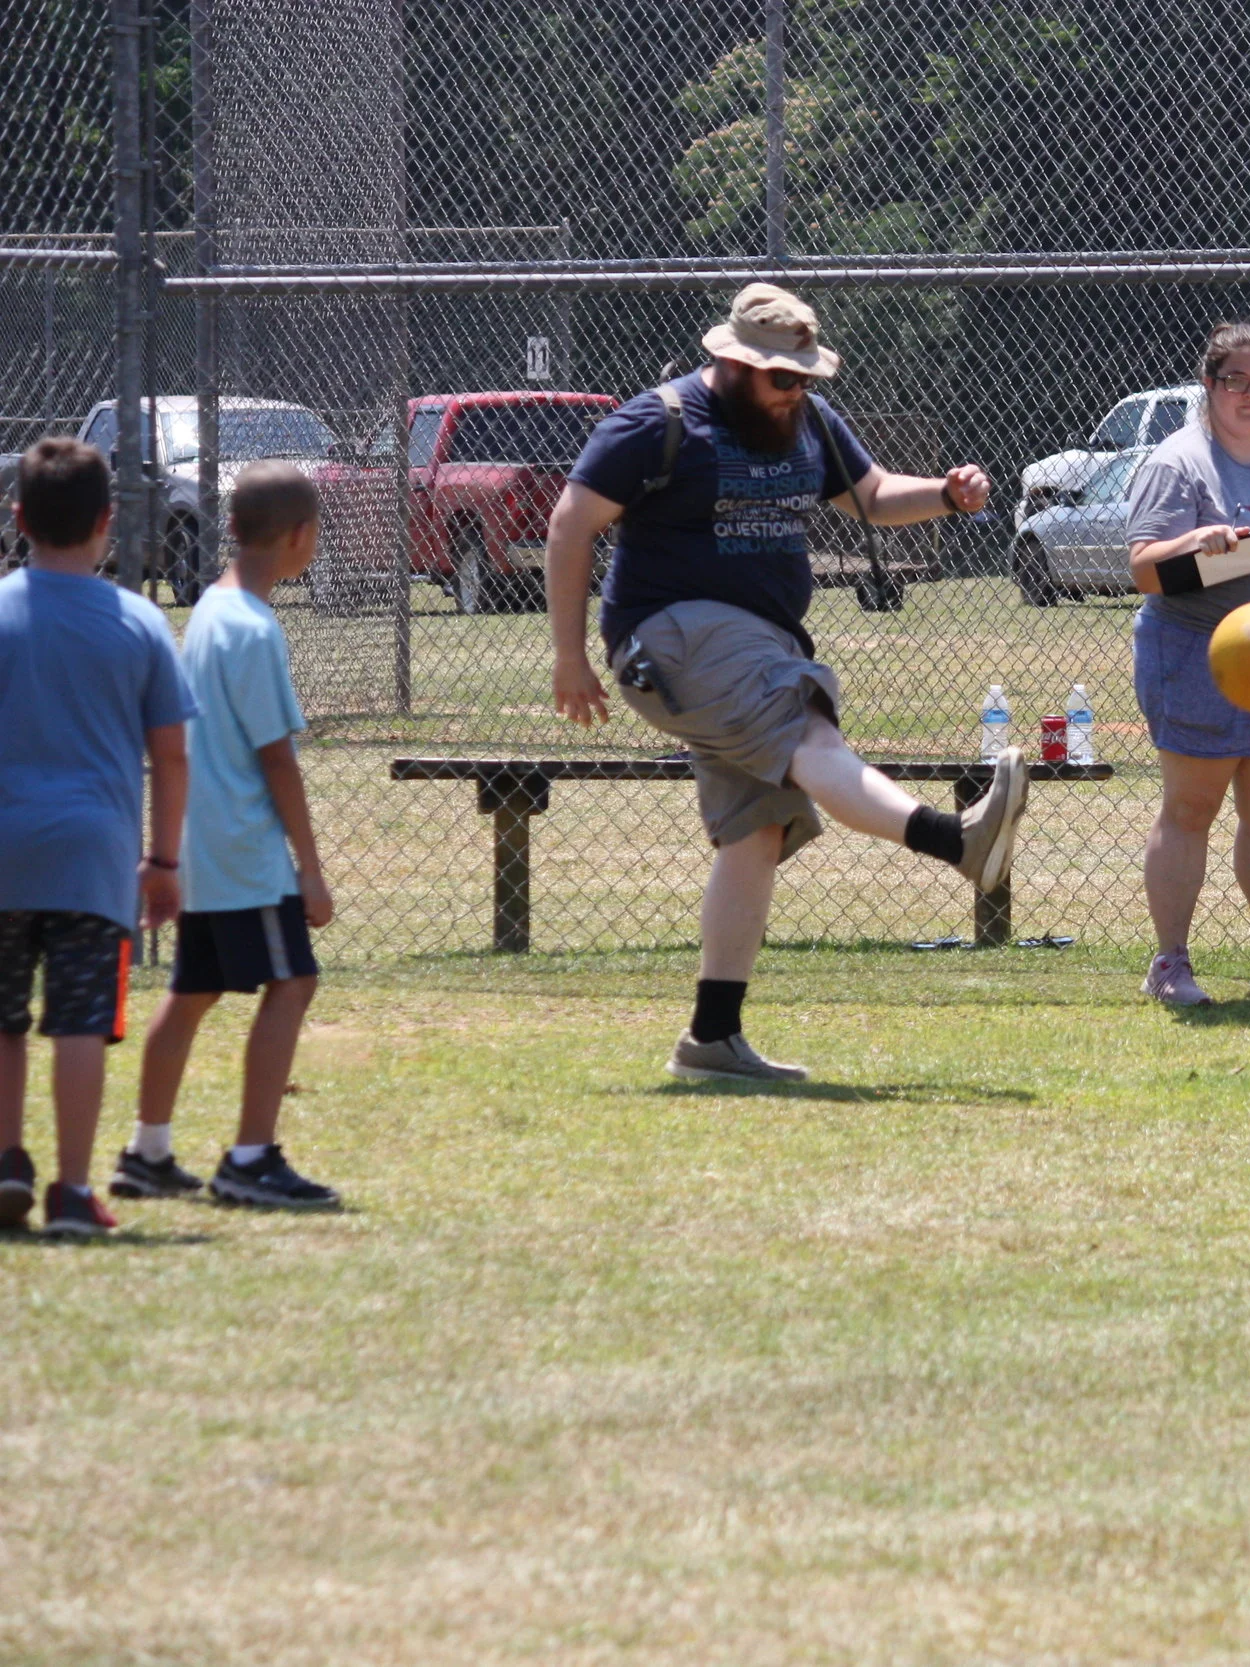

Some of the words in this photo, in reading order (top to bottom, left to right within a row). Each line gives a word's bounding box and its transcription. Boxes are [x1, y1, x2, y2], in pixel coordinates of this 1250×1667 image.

[748, 464, 767, 479] WE
[768, 462, 792, 477] DO
[718, 473, 820, 498] PRECISION
